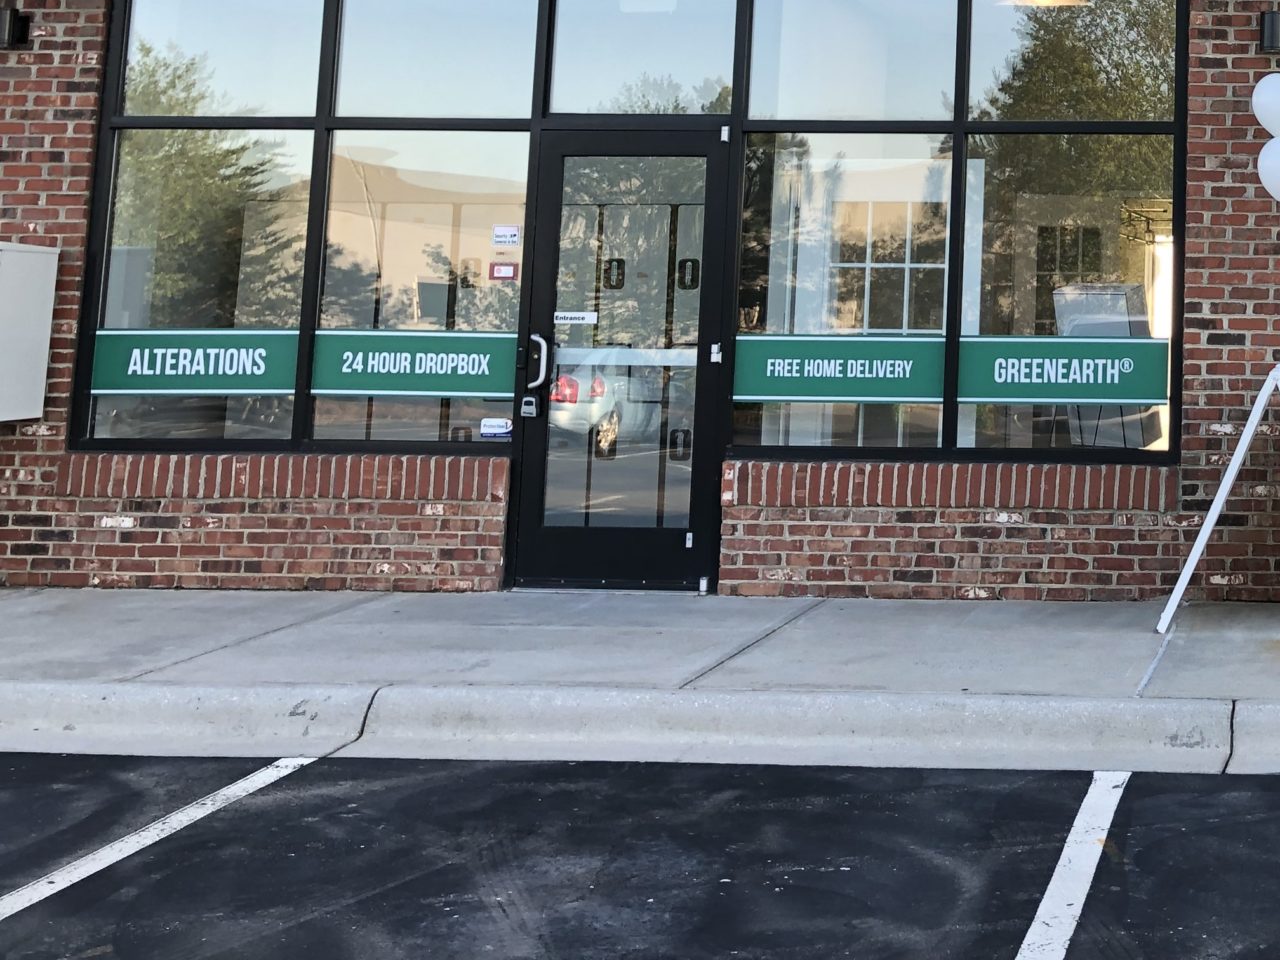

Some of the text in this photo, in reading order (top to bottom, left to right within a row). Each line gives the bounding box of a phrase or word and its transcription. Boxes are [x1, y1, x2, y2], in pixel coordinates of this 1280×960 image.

[127, 348, 267, 376] ALTERATIONS
[341, 351, 491, 375] 24 HOUR DROPBOX
[766, 358, 913, 378] FREE HOME DELIVERY
